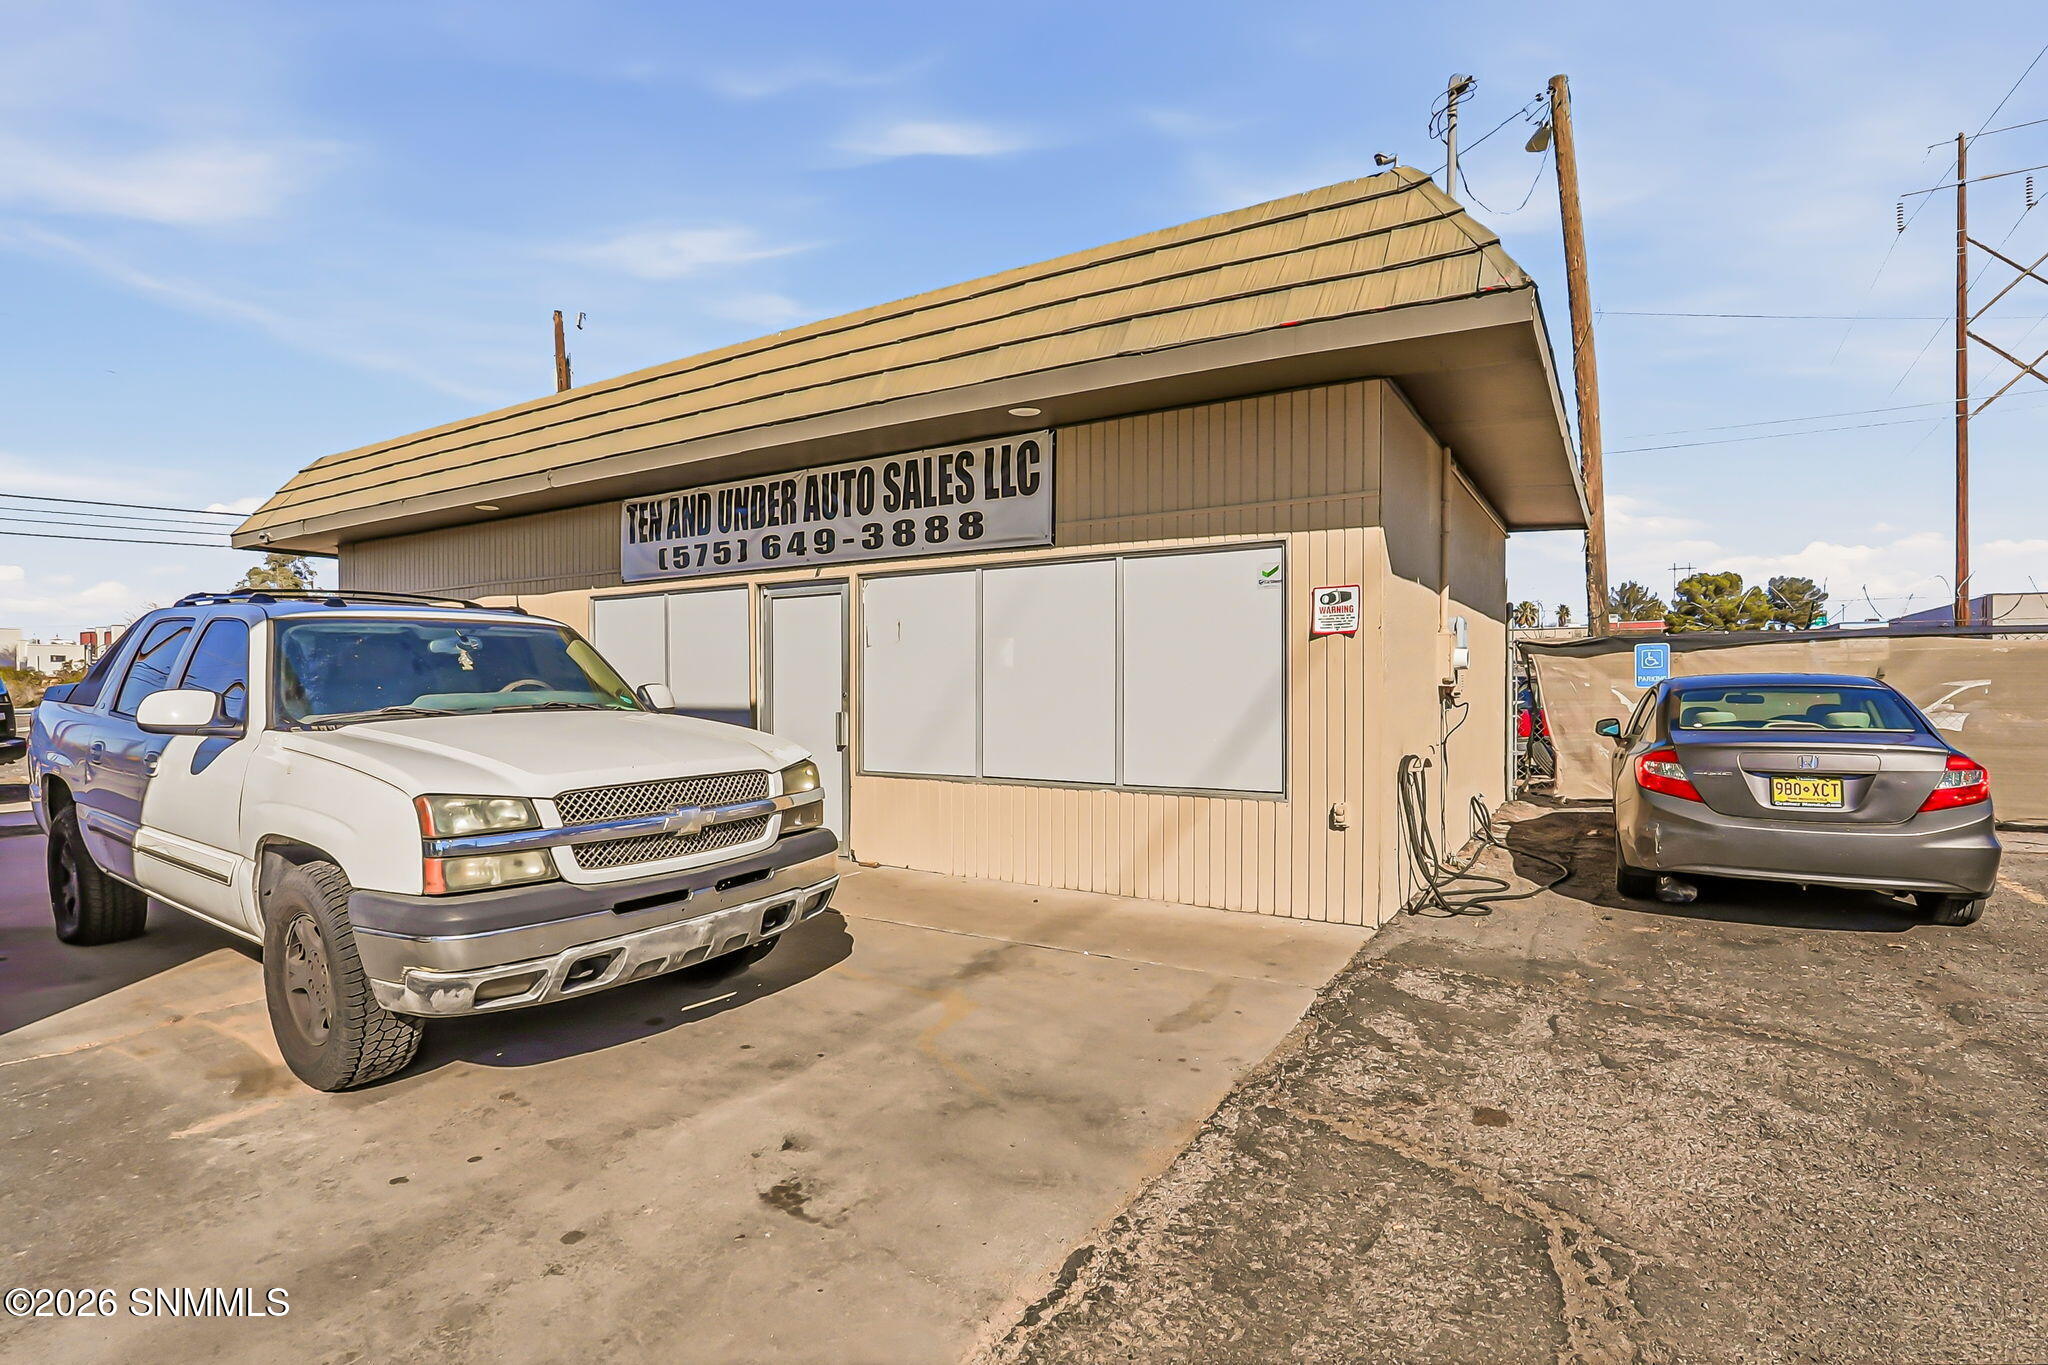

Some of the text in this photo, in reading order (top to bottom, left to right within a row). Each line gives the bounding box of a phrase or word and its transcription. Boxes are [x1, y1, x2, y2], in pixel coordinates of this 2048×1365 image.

[666, 492, 712, 540] AND
[717, 480, 797, 534] UNDER
[803, 466, 874, 522] AUTO
[882, 450, 975, 513] SALES
[983, 440, 1041, 501] LLC
[658, 511, 985, 571] (575) 649-3888
[1319, 605, 1354, 614] WARNING
